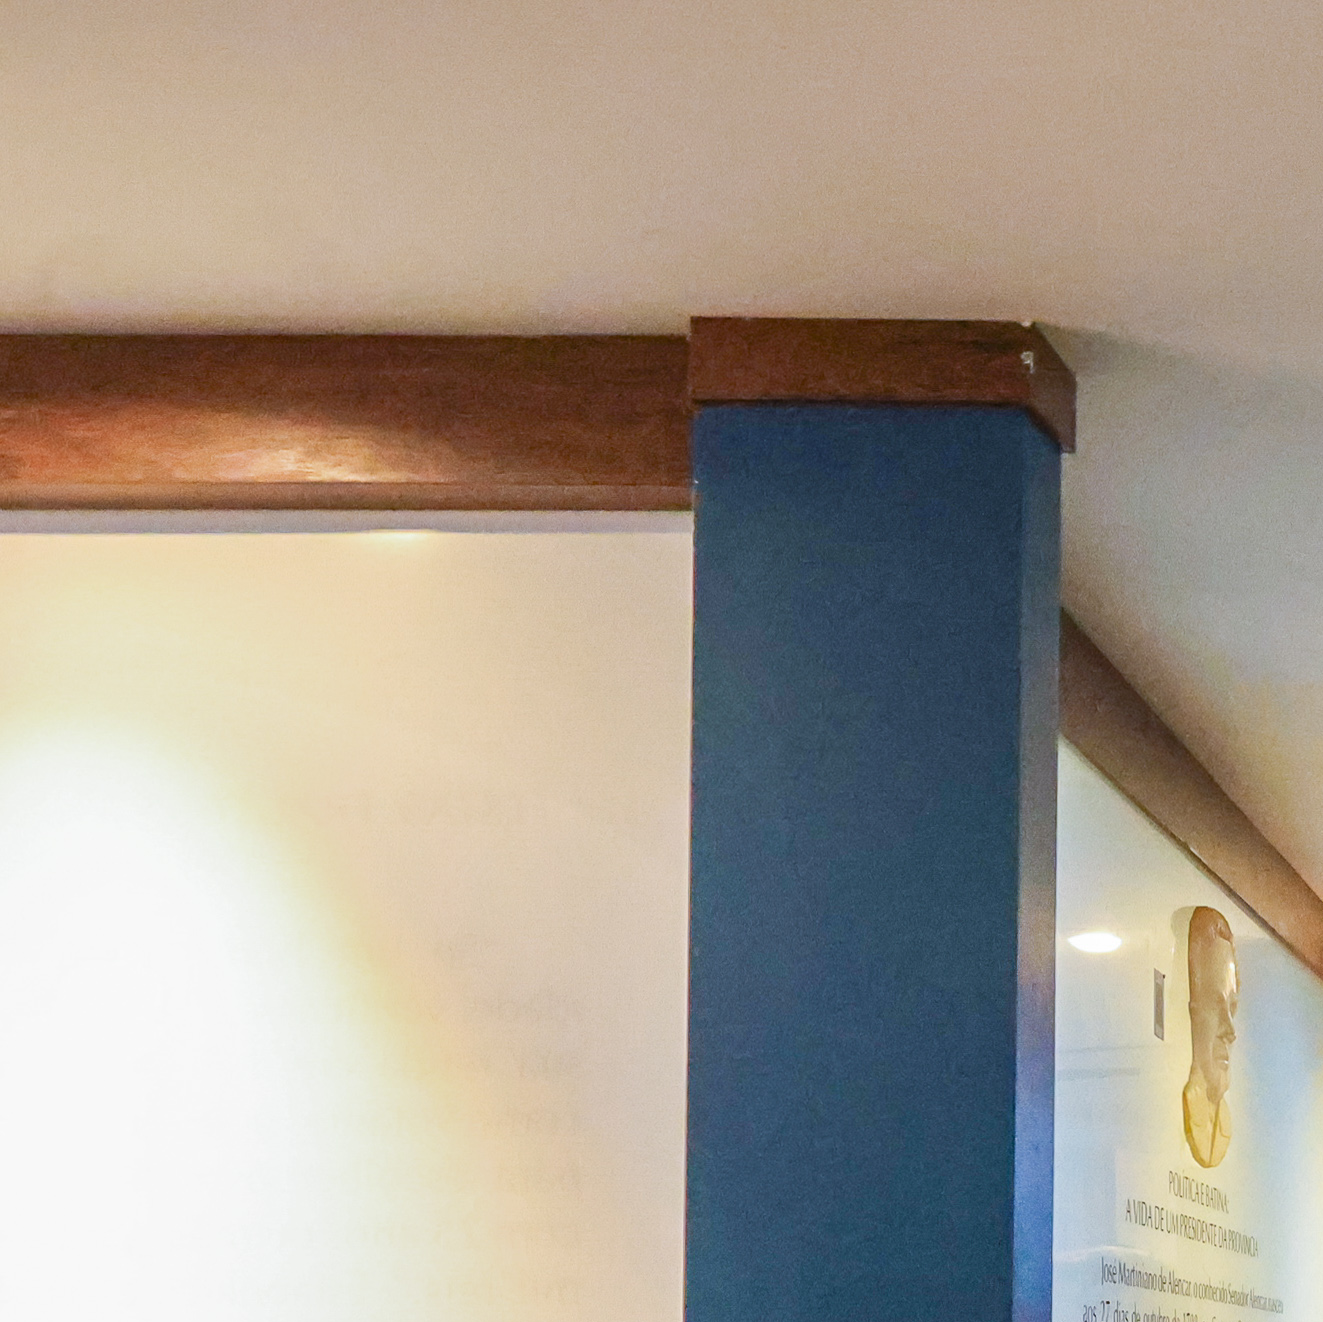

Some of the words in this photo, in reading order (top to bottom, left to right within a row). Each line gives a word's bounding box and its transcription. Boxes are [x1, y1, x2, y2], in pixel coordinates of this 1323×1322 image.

[1133, 1199, 1153, 1228] VIDA
[1154, 1205, 1164, 1232] DE
[1166, 1210, 1179, 1235] UM
[1180, 1214, 1217, 1247] PRESIDENTE
[1101, 1256, 1117, 1286] José
[1157, 1266, 1167, 1293] de
